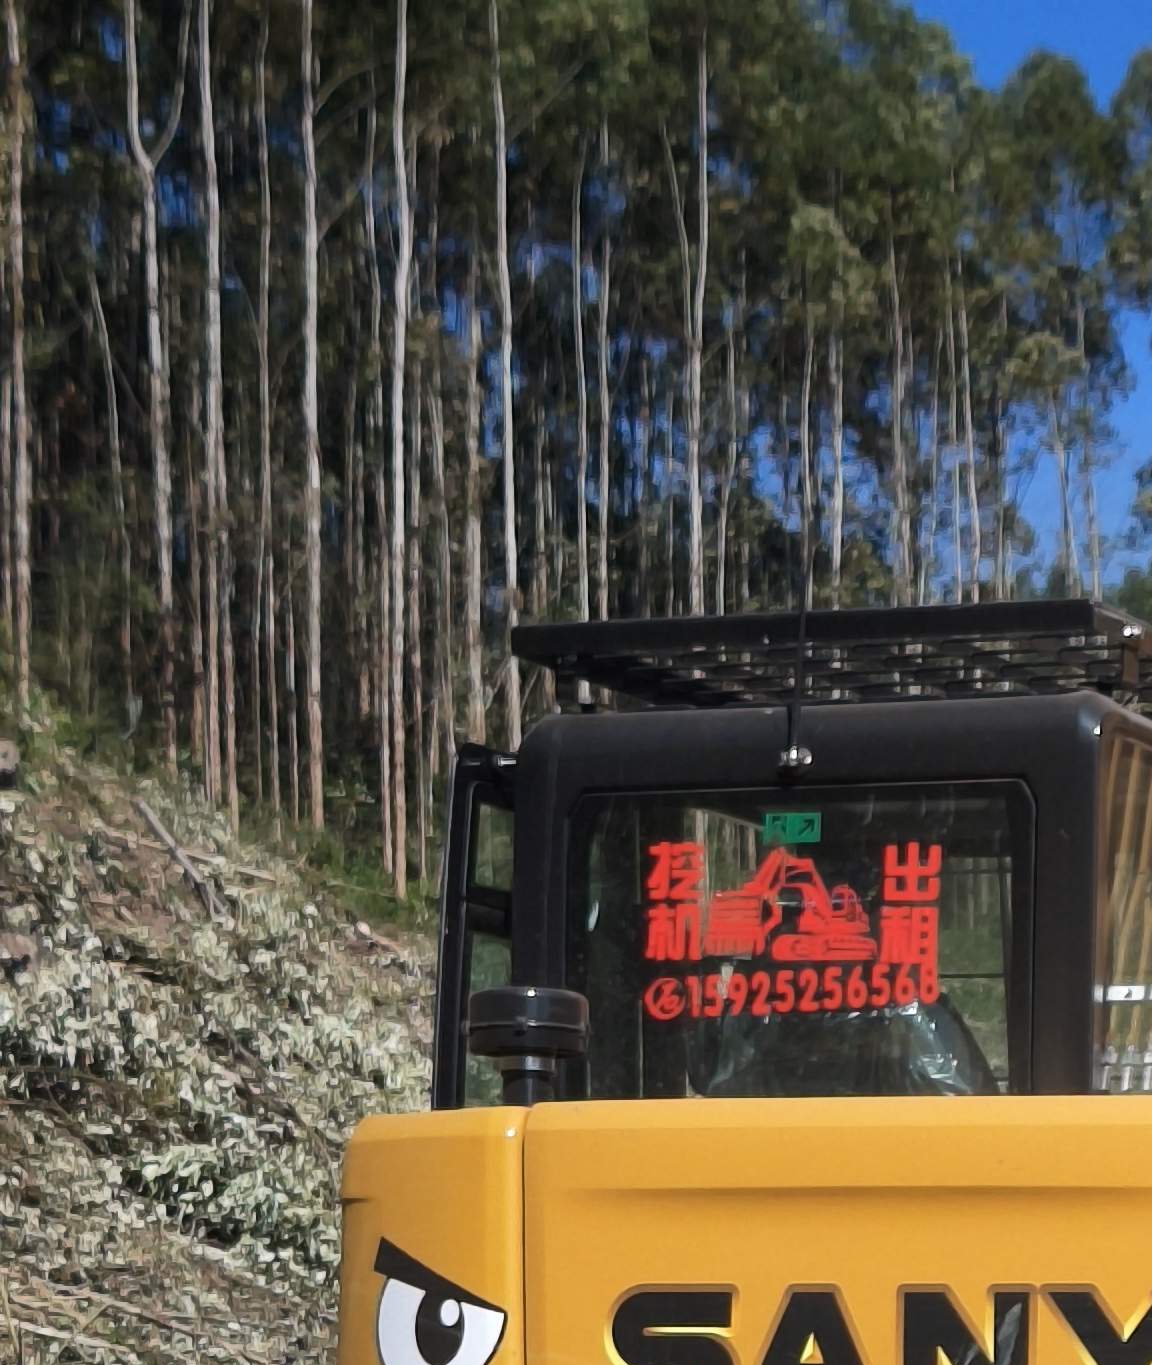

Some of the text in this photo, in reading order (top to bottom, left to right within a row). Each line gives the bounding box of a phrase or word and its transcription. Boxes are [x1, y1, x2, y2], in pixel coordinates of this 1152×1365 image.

[646, 841, 703, 961] 挖机
[880, 842, 942, 963] 出租
[685, 962, 939, 1018] 15925256568
